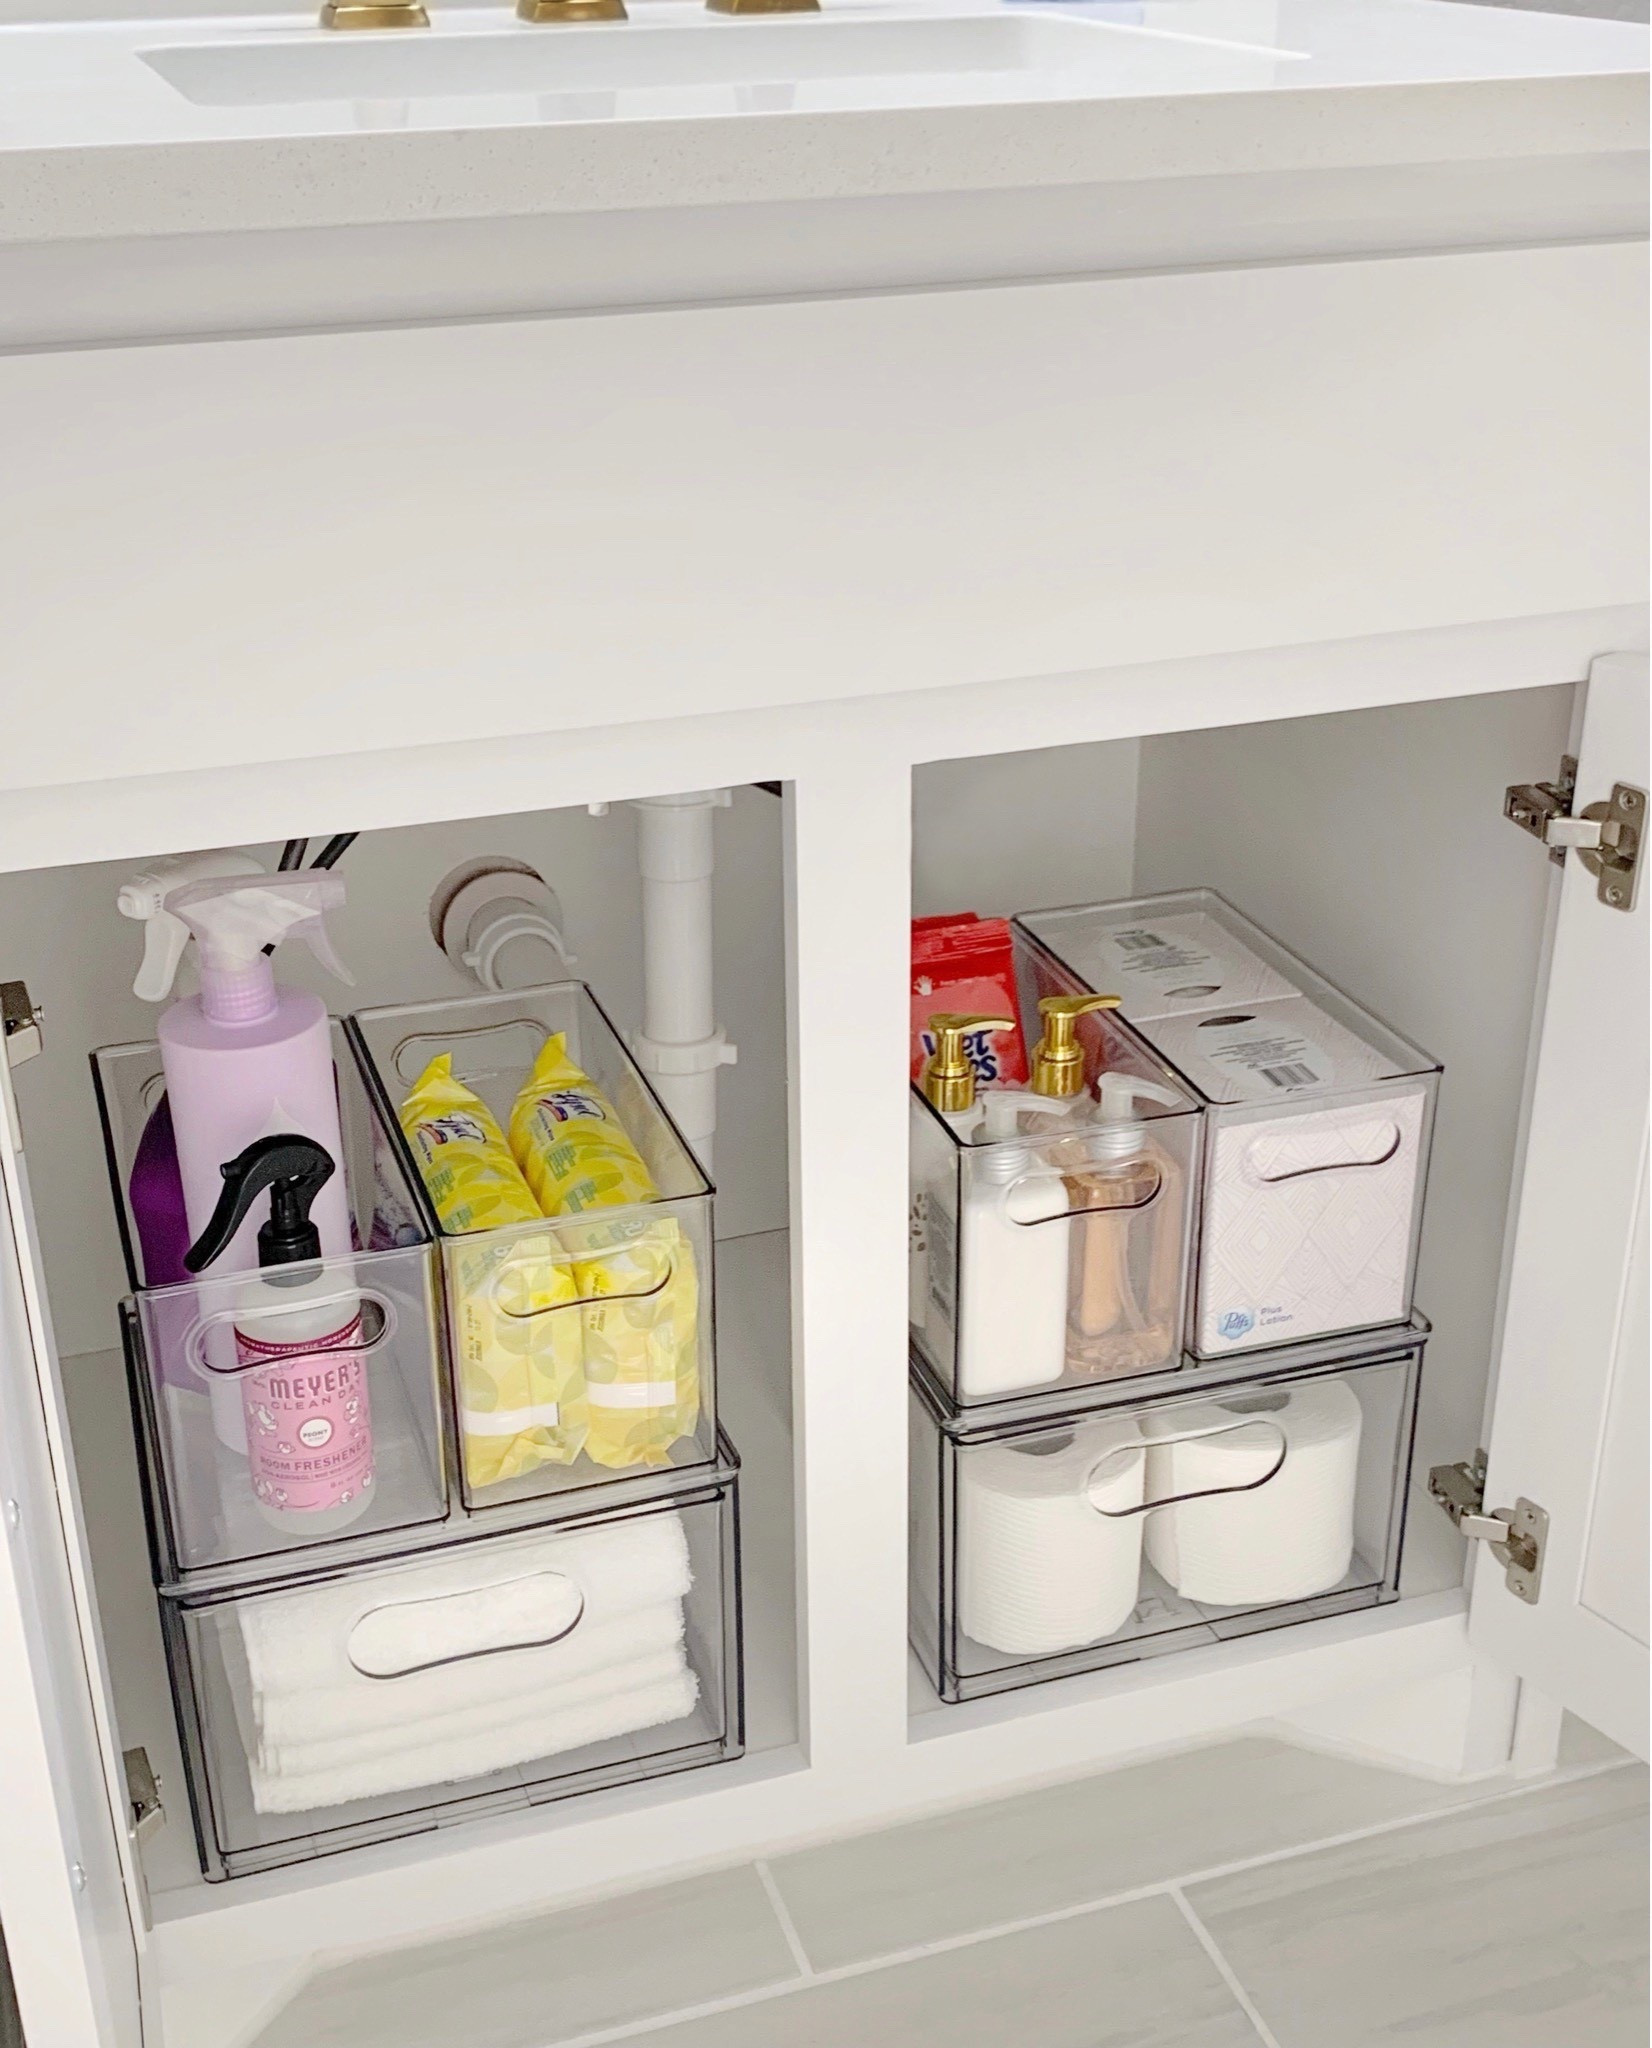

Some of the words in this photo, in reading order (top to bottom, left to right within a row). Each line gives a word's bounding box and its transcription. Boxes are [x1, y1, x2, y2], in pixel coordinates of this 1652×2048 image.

[269, 1360, 360, 1399] MEYER'S
[270, 1395, 332, 1411] CLEAN
[294, 1435, 367, 1472] FRESHENER
